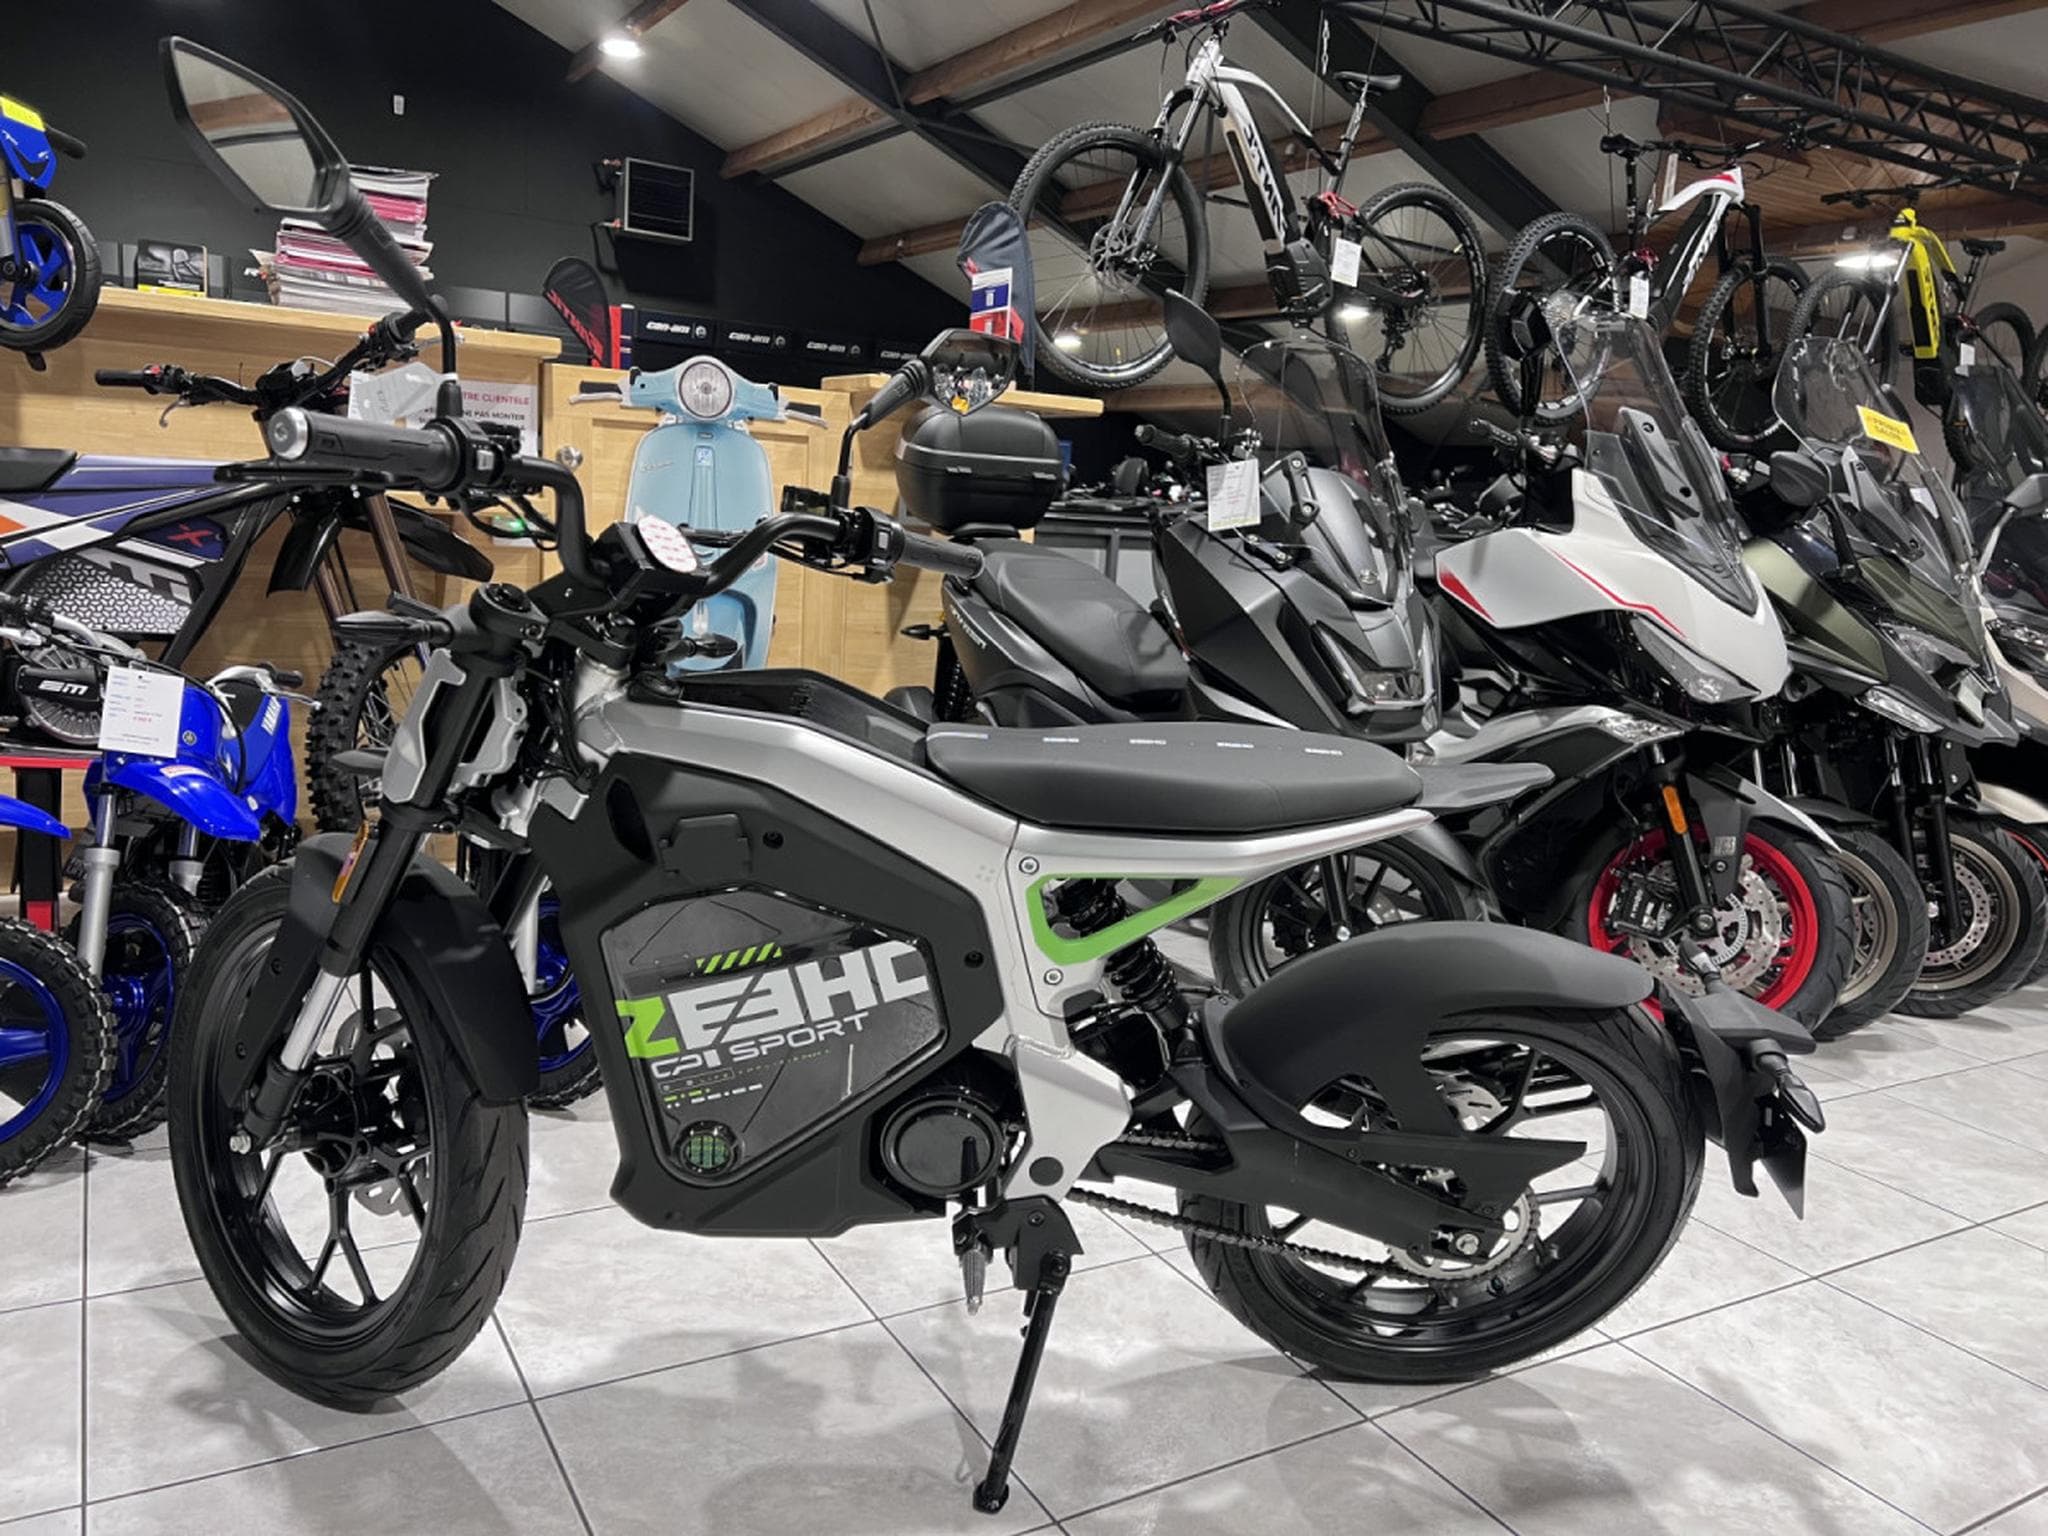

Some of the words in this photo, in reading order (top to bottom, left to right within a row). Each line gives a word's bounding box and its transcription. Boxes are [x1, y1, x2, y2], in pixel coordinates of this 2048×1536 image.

[646, 321, 691, 334] can-am
[728, 331, 771, 344] can-am
[492, 411, 526, 421] MONTER
[728, 1011, 870, 1063] SPORT
